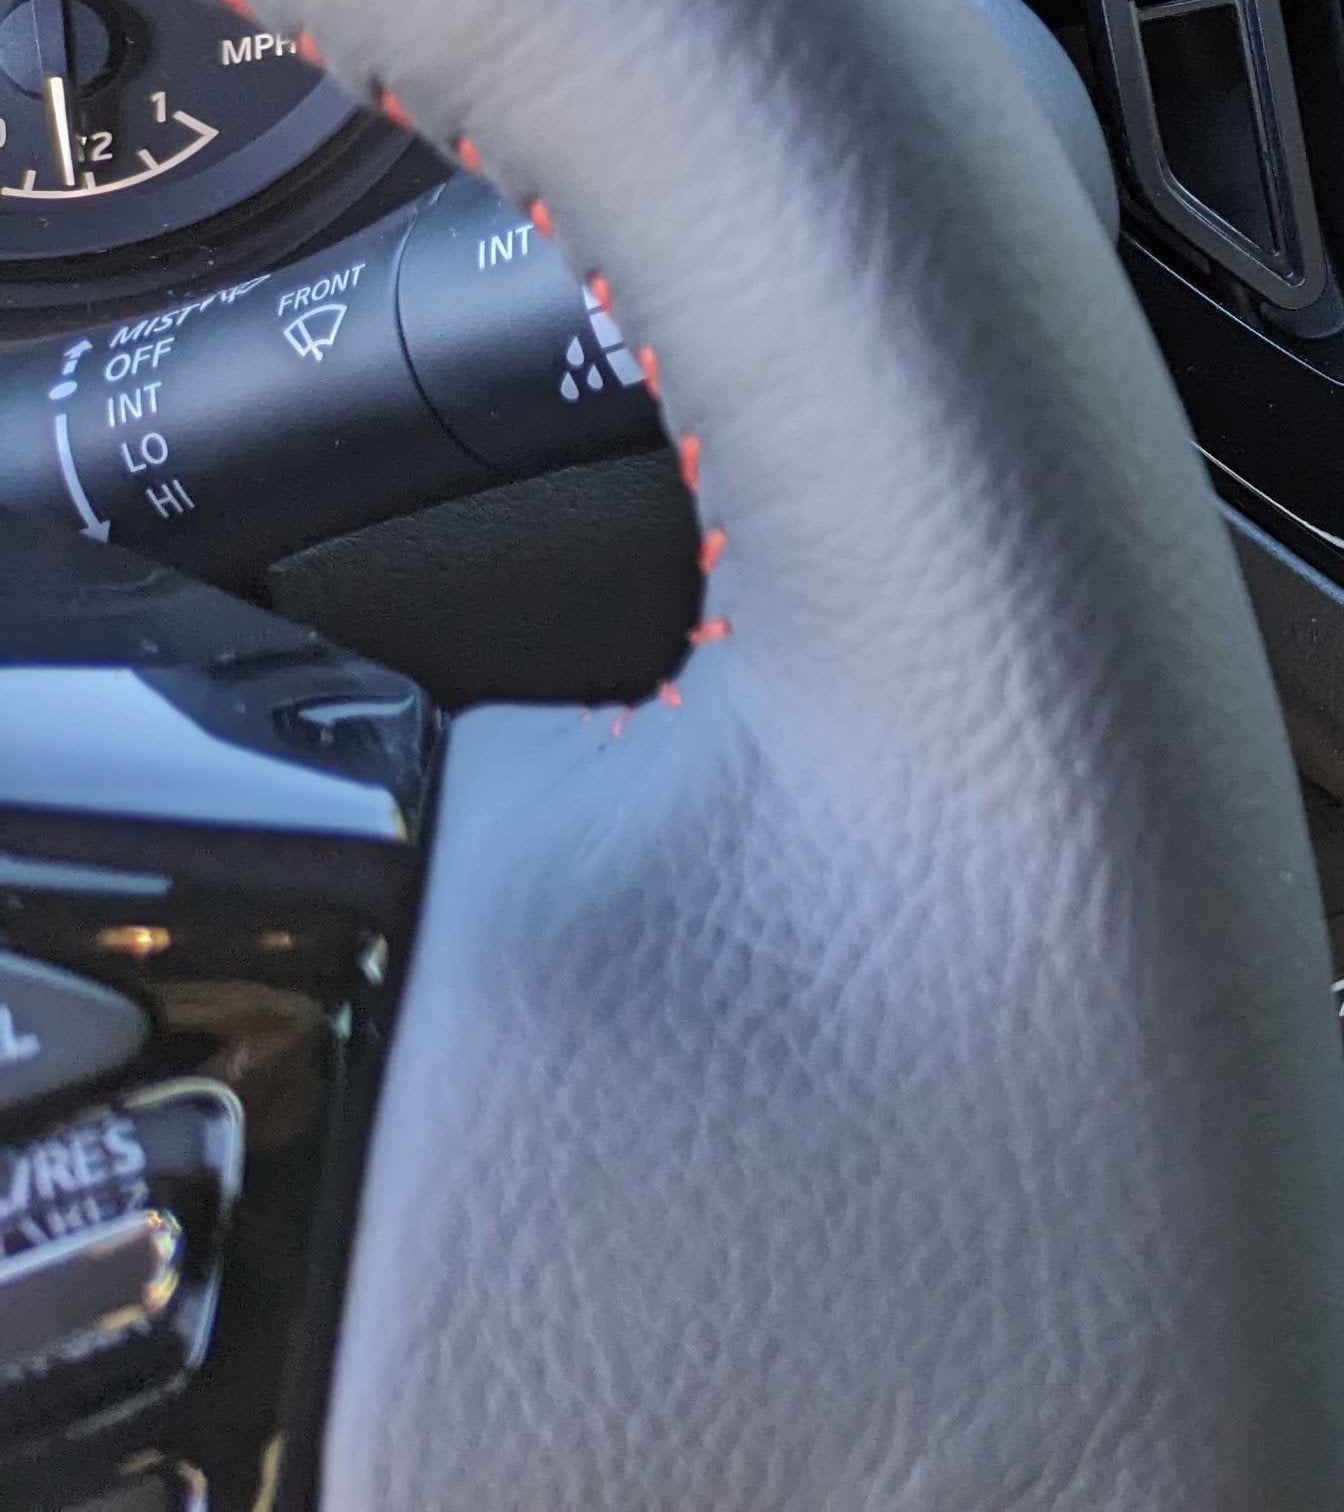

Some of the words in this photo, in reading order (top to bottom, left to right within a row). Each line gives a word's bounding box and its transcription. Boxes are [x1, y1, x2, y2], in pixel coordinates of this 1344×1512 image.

[221, 33, 298, 66] MPH
[151, 92, 166, 122] 1
[477, 224, 533, 271] INT
[278, 263, 366, 317] FRONT
[110, 303, 200, 348] MIST
[104, 337, 175, 382] OFF
[106, 381, 162, 427] INT
[121, 432, 168, 474] LO
[145, 480, 195, 519] HI
